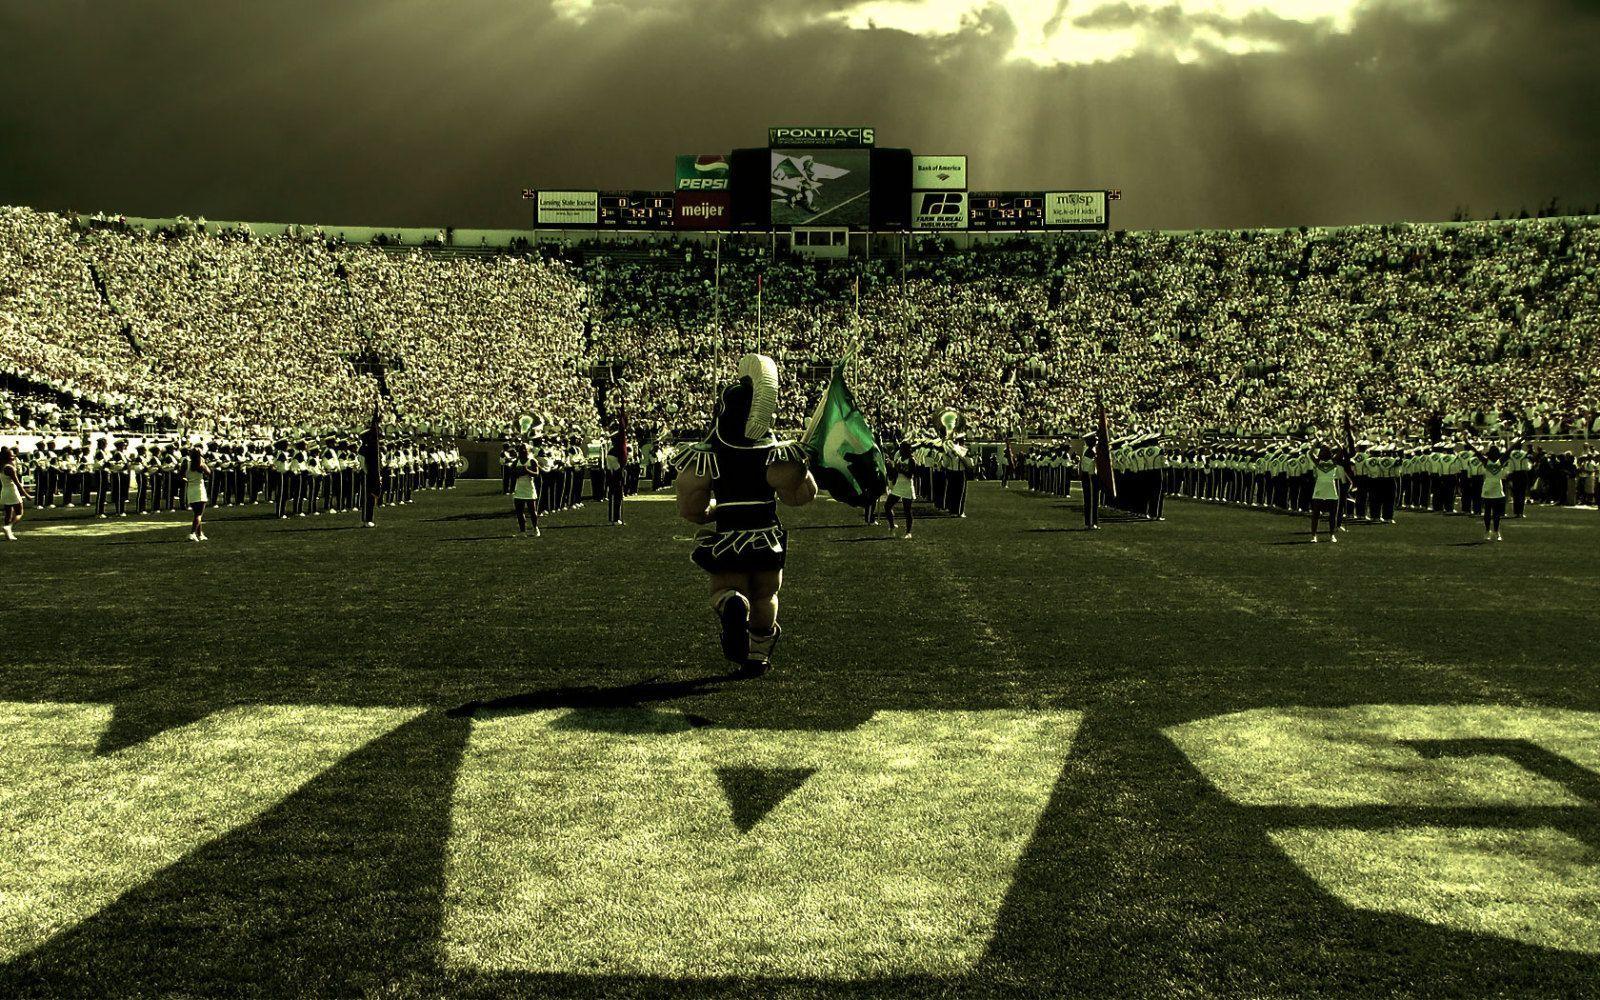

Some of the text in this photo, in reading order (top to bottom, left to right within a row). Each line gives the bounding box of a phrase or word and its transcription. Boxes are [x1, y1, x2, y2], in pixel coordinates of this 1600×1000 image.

[777, 128, 859, 138] PONTIAC
[862, 129, 874, 144] S
[679, 178, 728, 189] PEPSI
[1107, 189, 1121, 200] 25
[540, 199, 560, 207] Lansing
[682, 202, 724, 219] meijer
